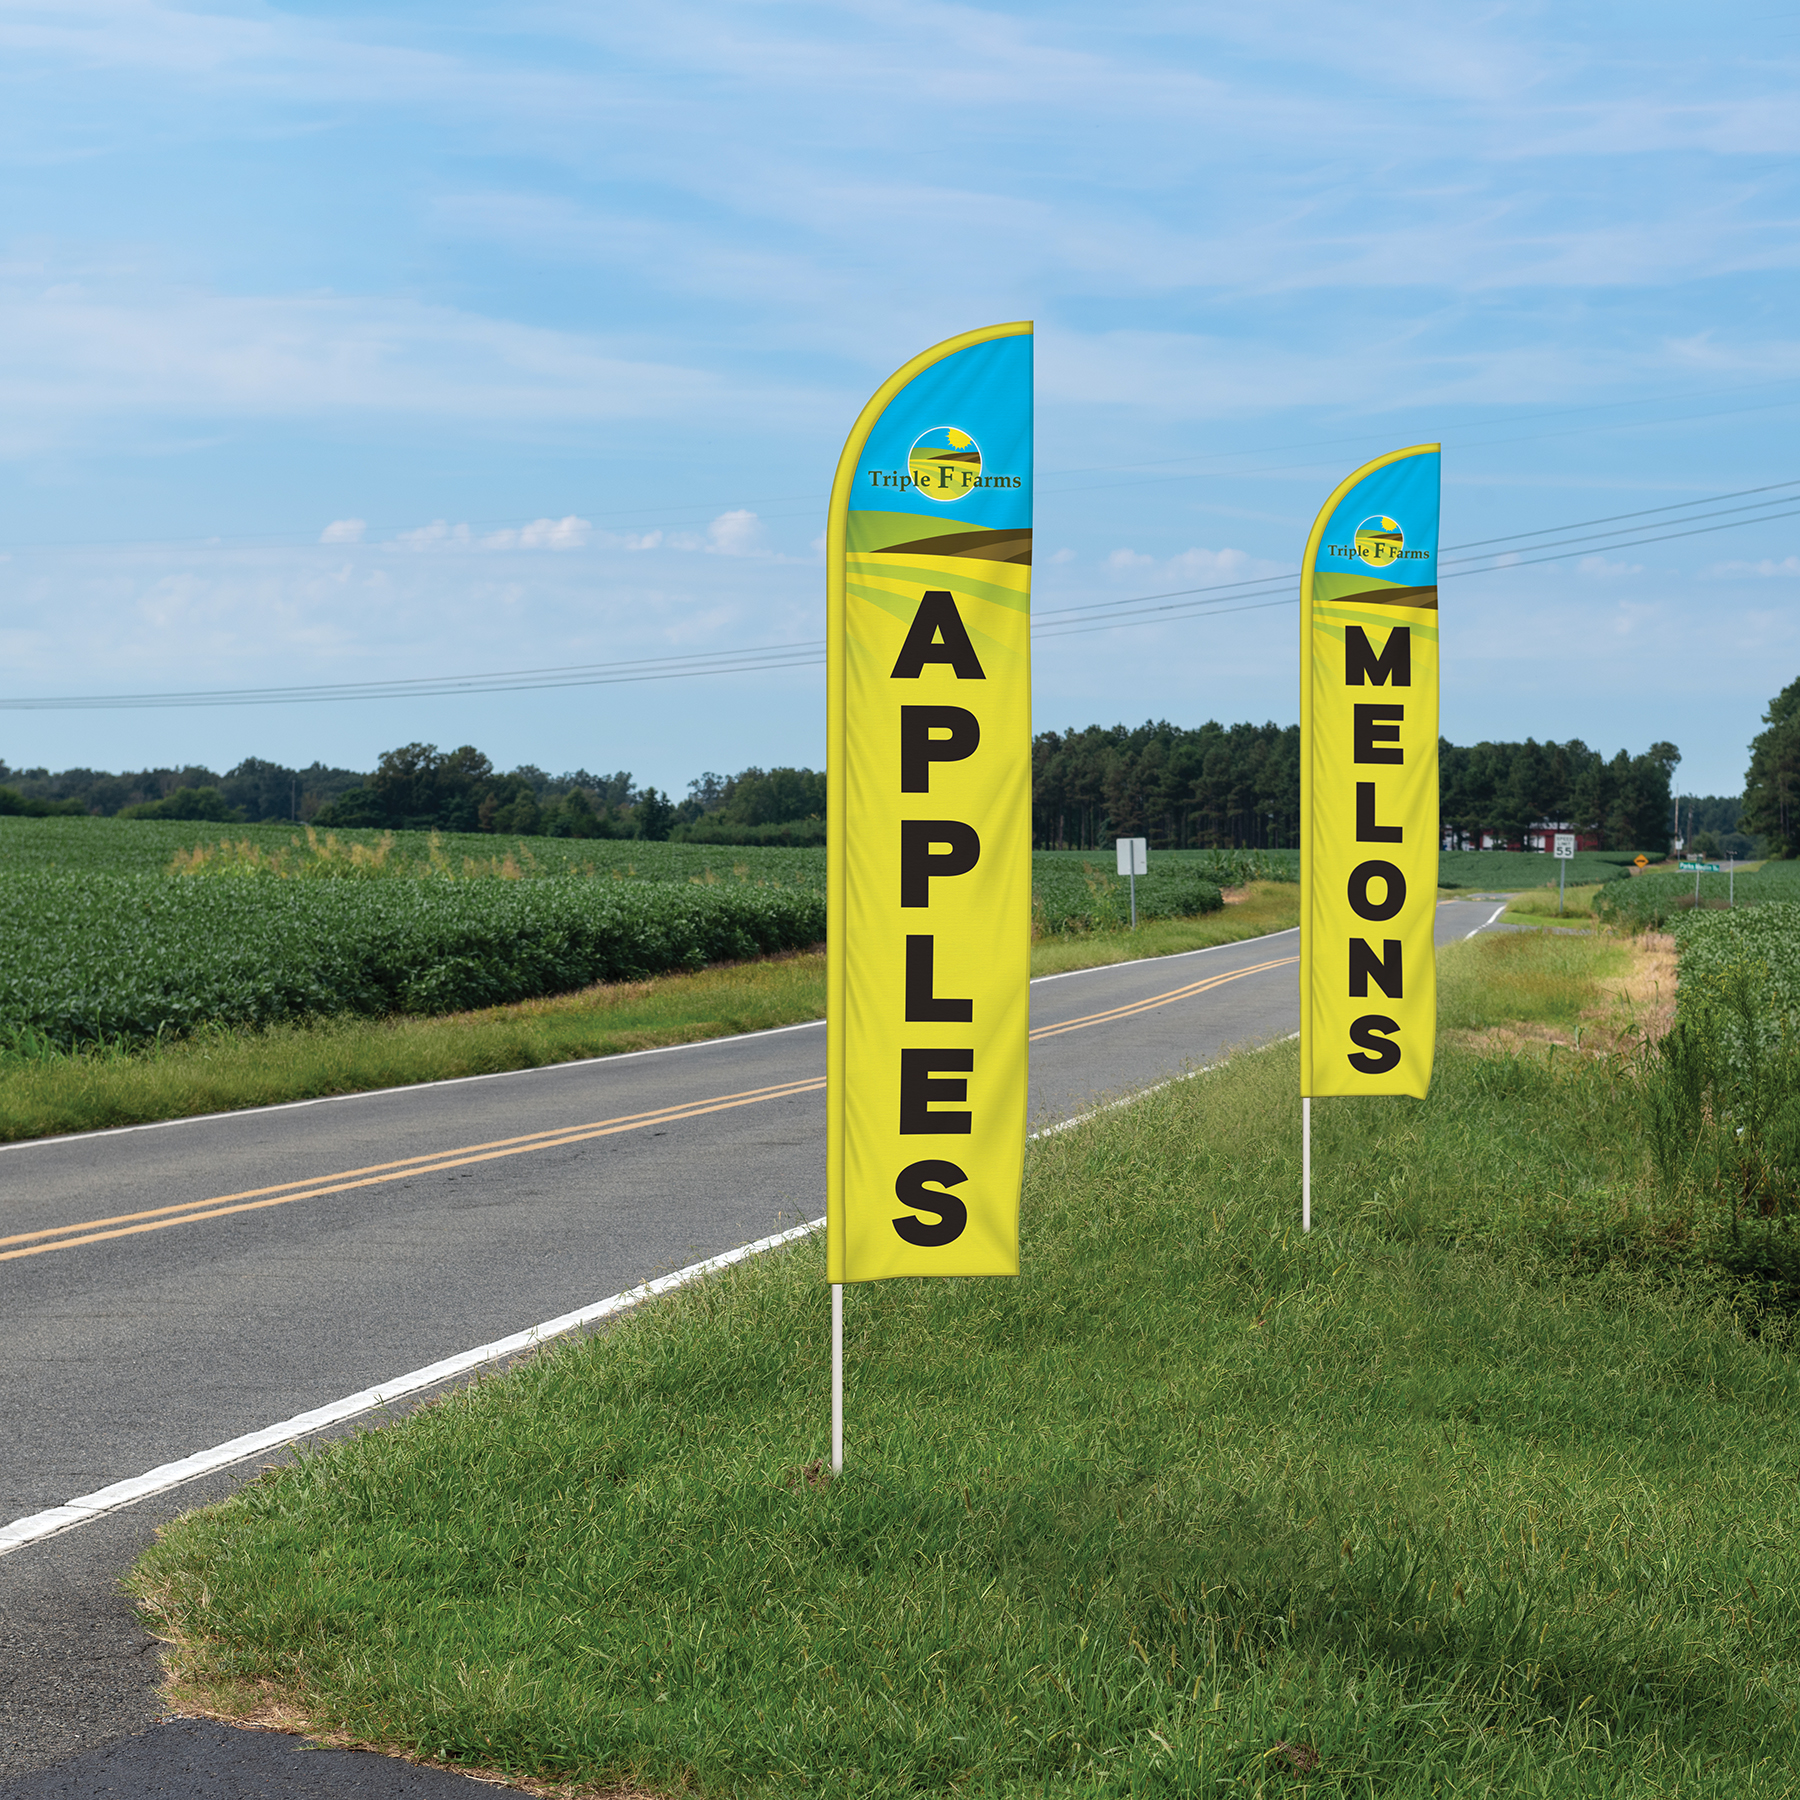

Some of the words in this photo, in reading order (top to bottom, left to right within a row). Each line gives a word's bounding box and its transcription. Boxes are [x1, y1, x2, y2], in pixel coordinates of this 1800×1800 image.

[868, 470, 931, 492] Triple
[938, 466, 954, 488] F
[961, 471, 1022, 488] Farms
[1327, 545, 1370, 560] Triple
[1373, 542, 1386, 558] F
[1389, 547, 1430, 559] Farms
[1345, 626, 1410, 1074] MELONS
[1556, 846, 1572, 856] 55
[890, 591, 986, 1247] APPLES
